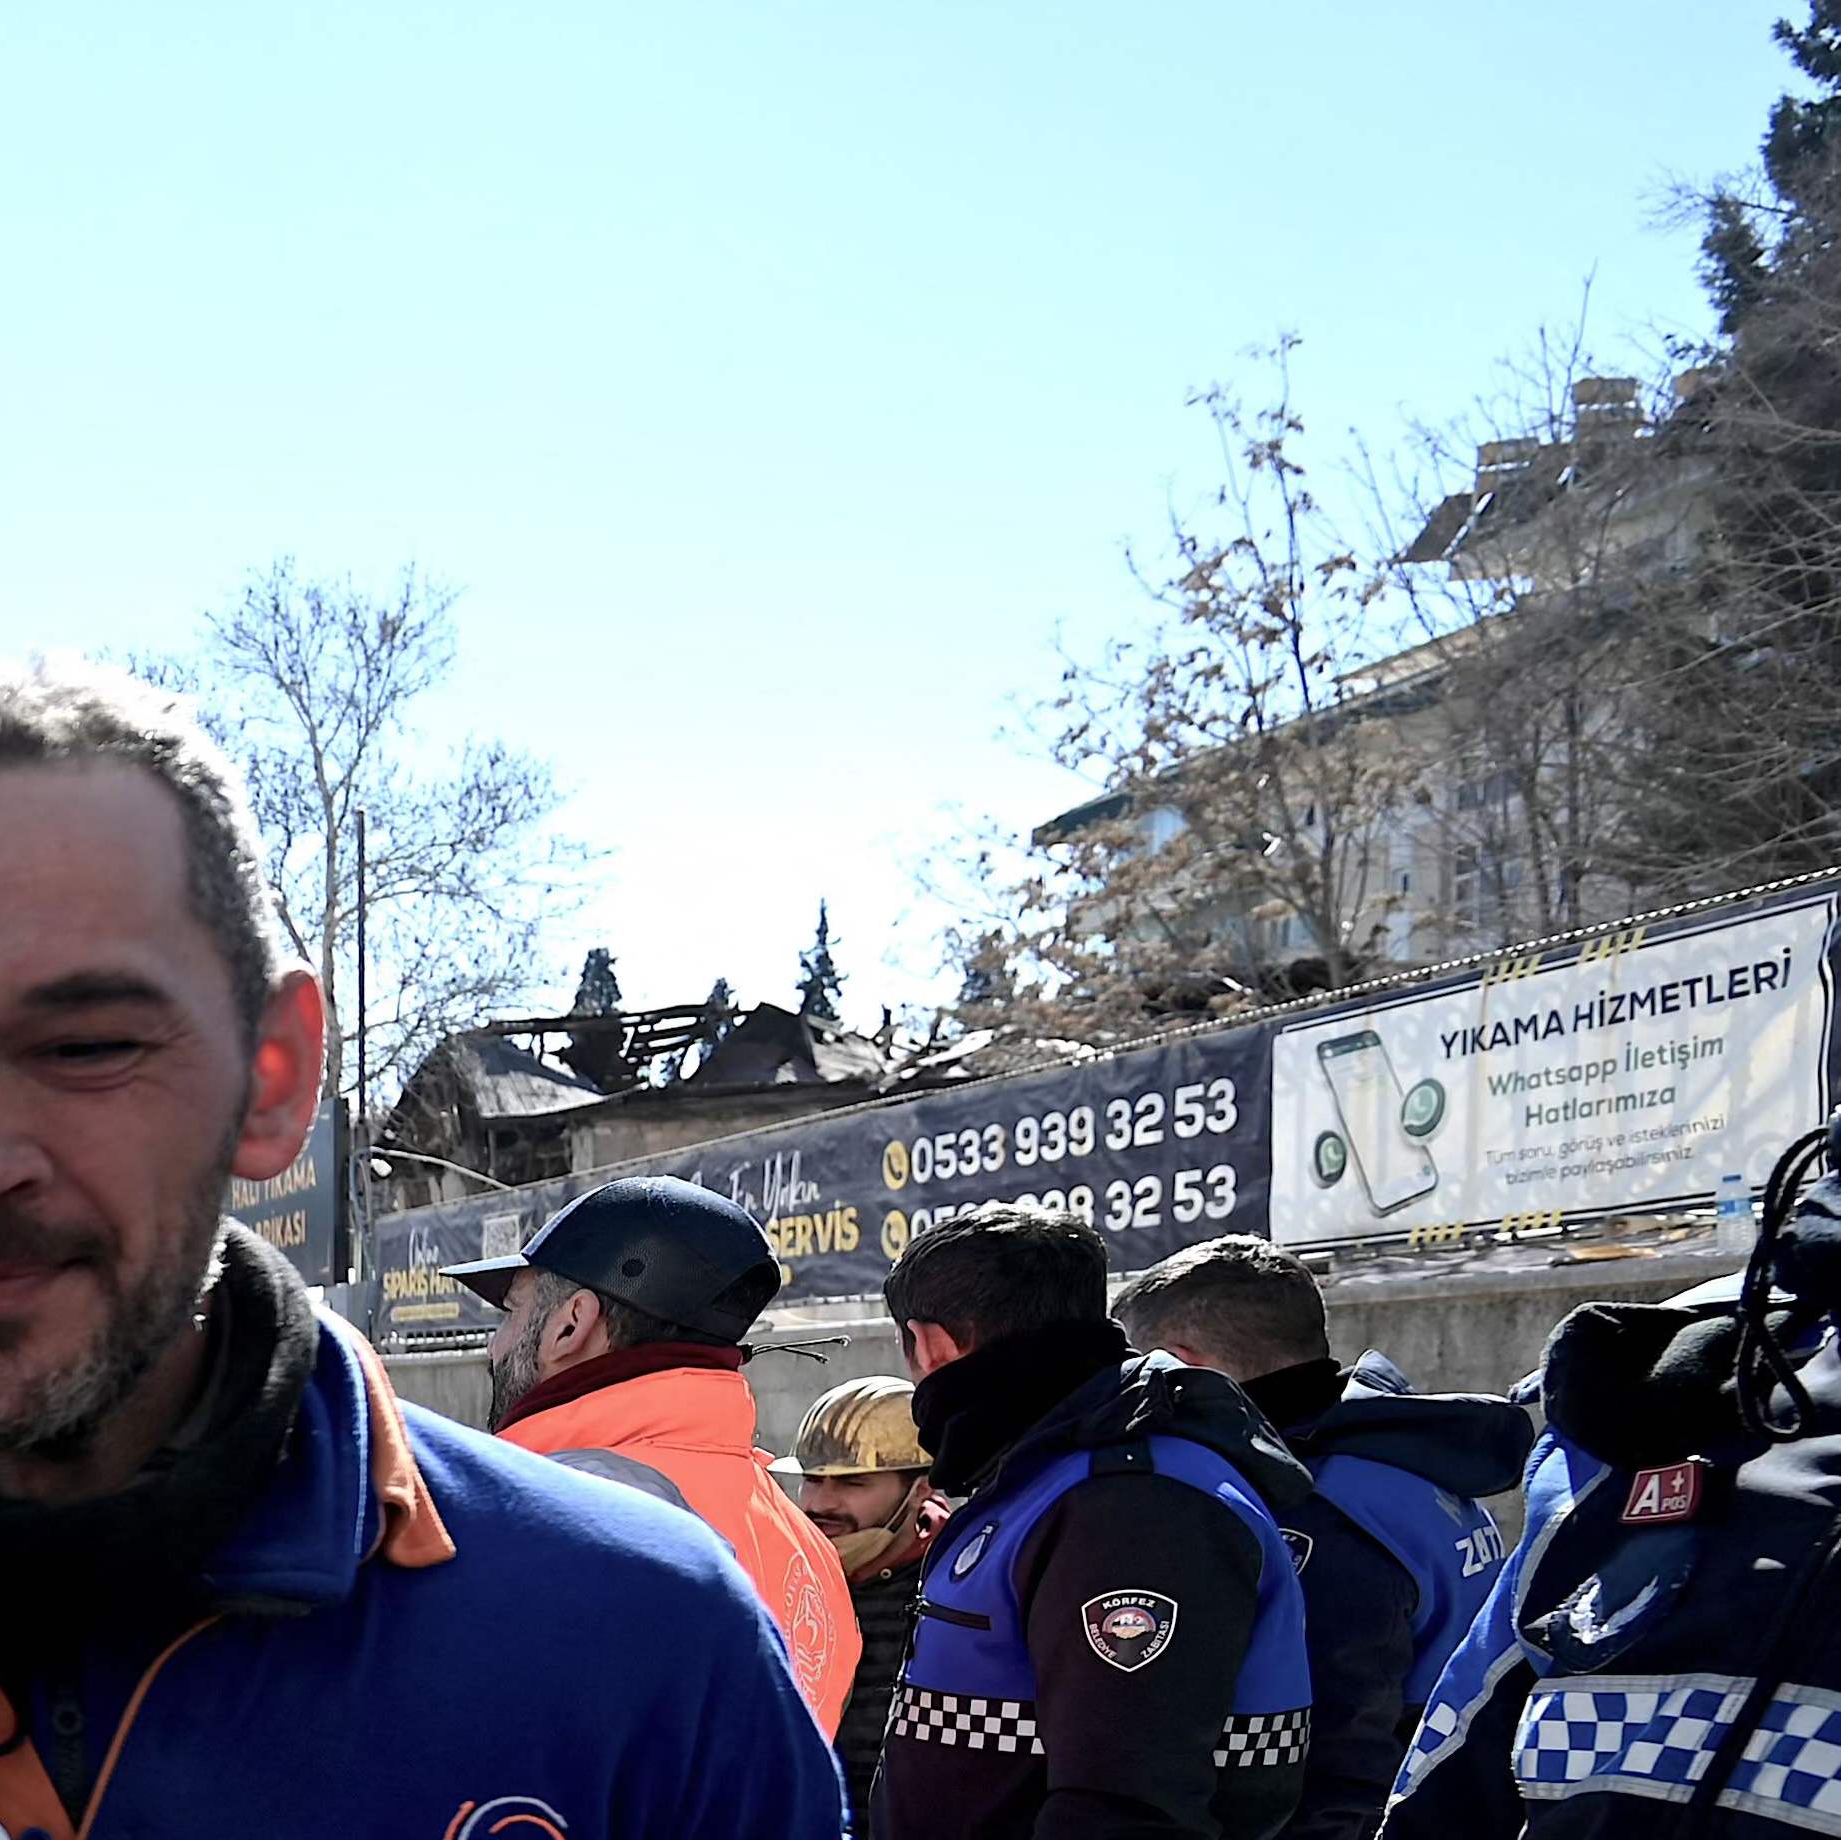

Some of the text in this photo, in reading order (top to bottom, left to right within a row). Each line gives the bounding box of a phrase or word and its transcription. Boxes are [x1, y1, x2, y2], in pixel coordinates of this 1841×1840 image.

[1440, 947, 1792, 1060] YIKAMA HİZMETLERİ
[1487, 1034, 1724, 1098] Whatsapp İletişim
[910, 1077, 1238, 1185] 0533 939 32 53
[1524, 1084, 1677, 1128] Hatlarımıza
[765, 1199, 862, 1259] SERVİS
[1104, 1174, 1163, 1232] 32
[1171, 1164, 1238, 1223] 53
